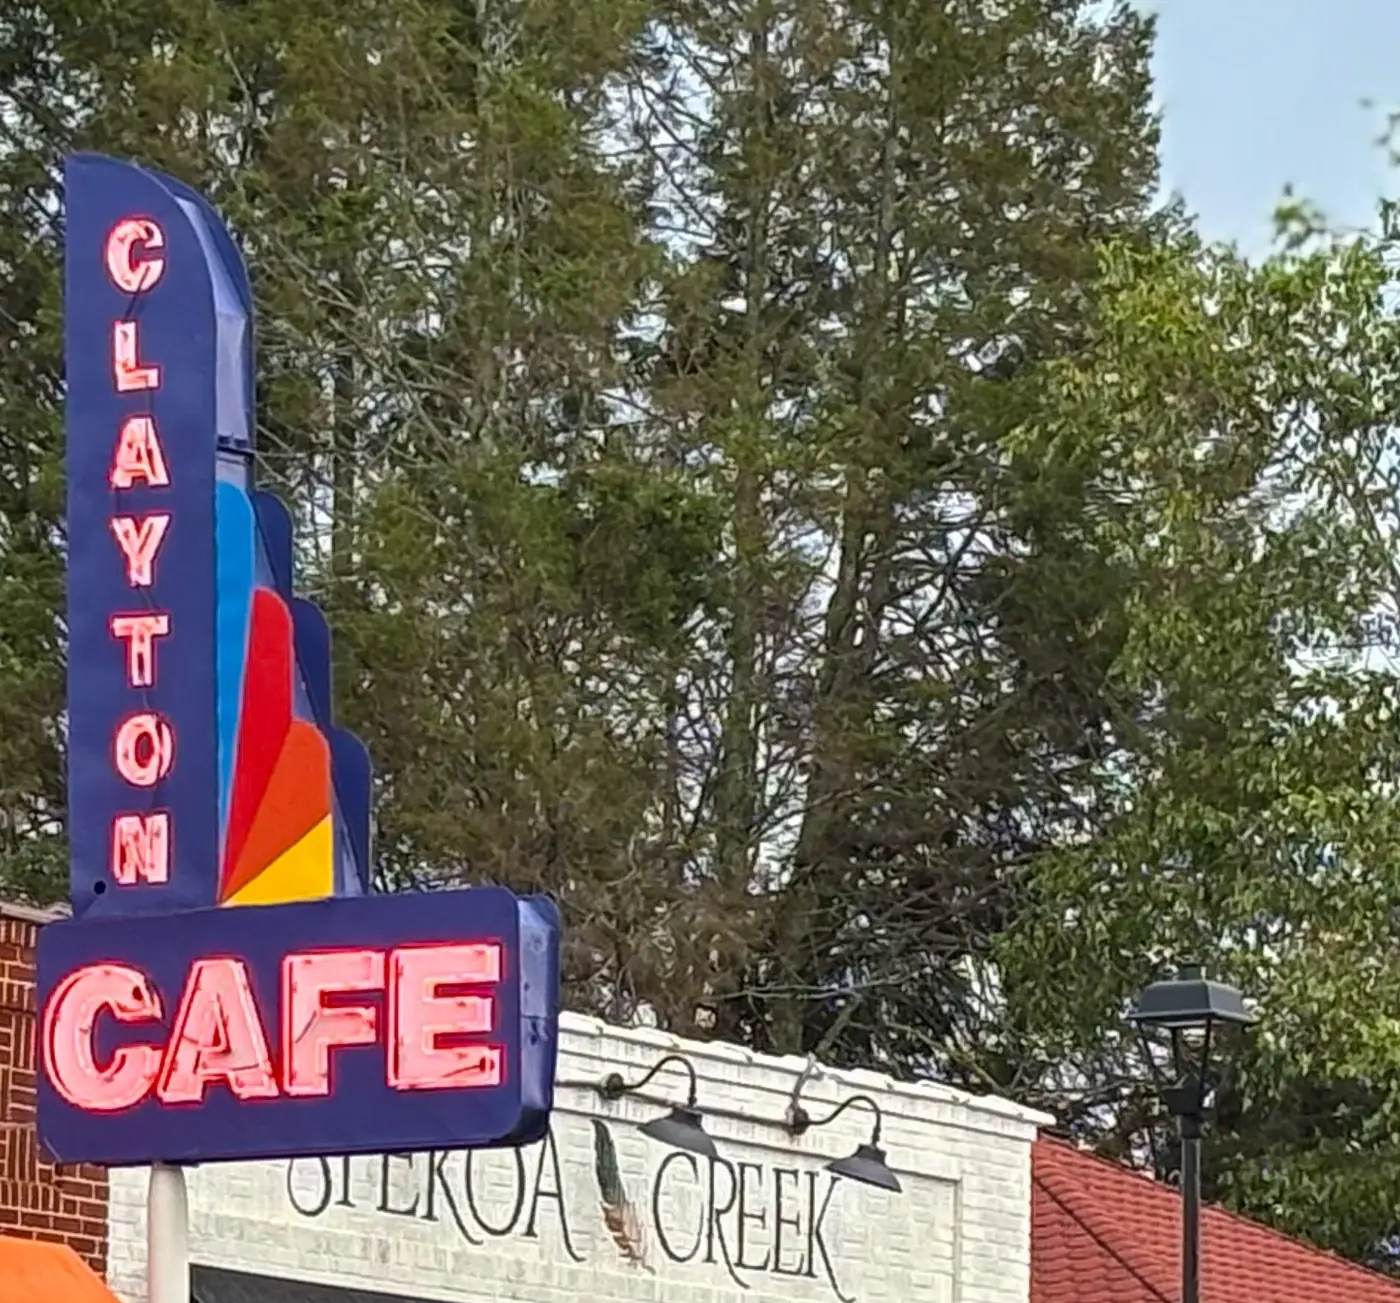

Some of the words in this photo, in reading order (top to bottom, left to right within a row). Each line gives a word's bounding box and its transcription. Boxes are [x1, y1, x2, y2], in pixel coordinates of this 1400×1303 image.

[104, 216, 173, 886] CLAYTON
[42, 941, 505, 1114] CAFE
[652, 1151, 857, 1303] CREEK
